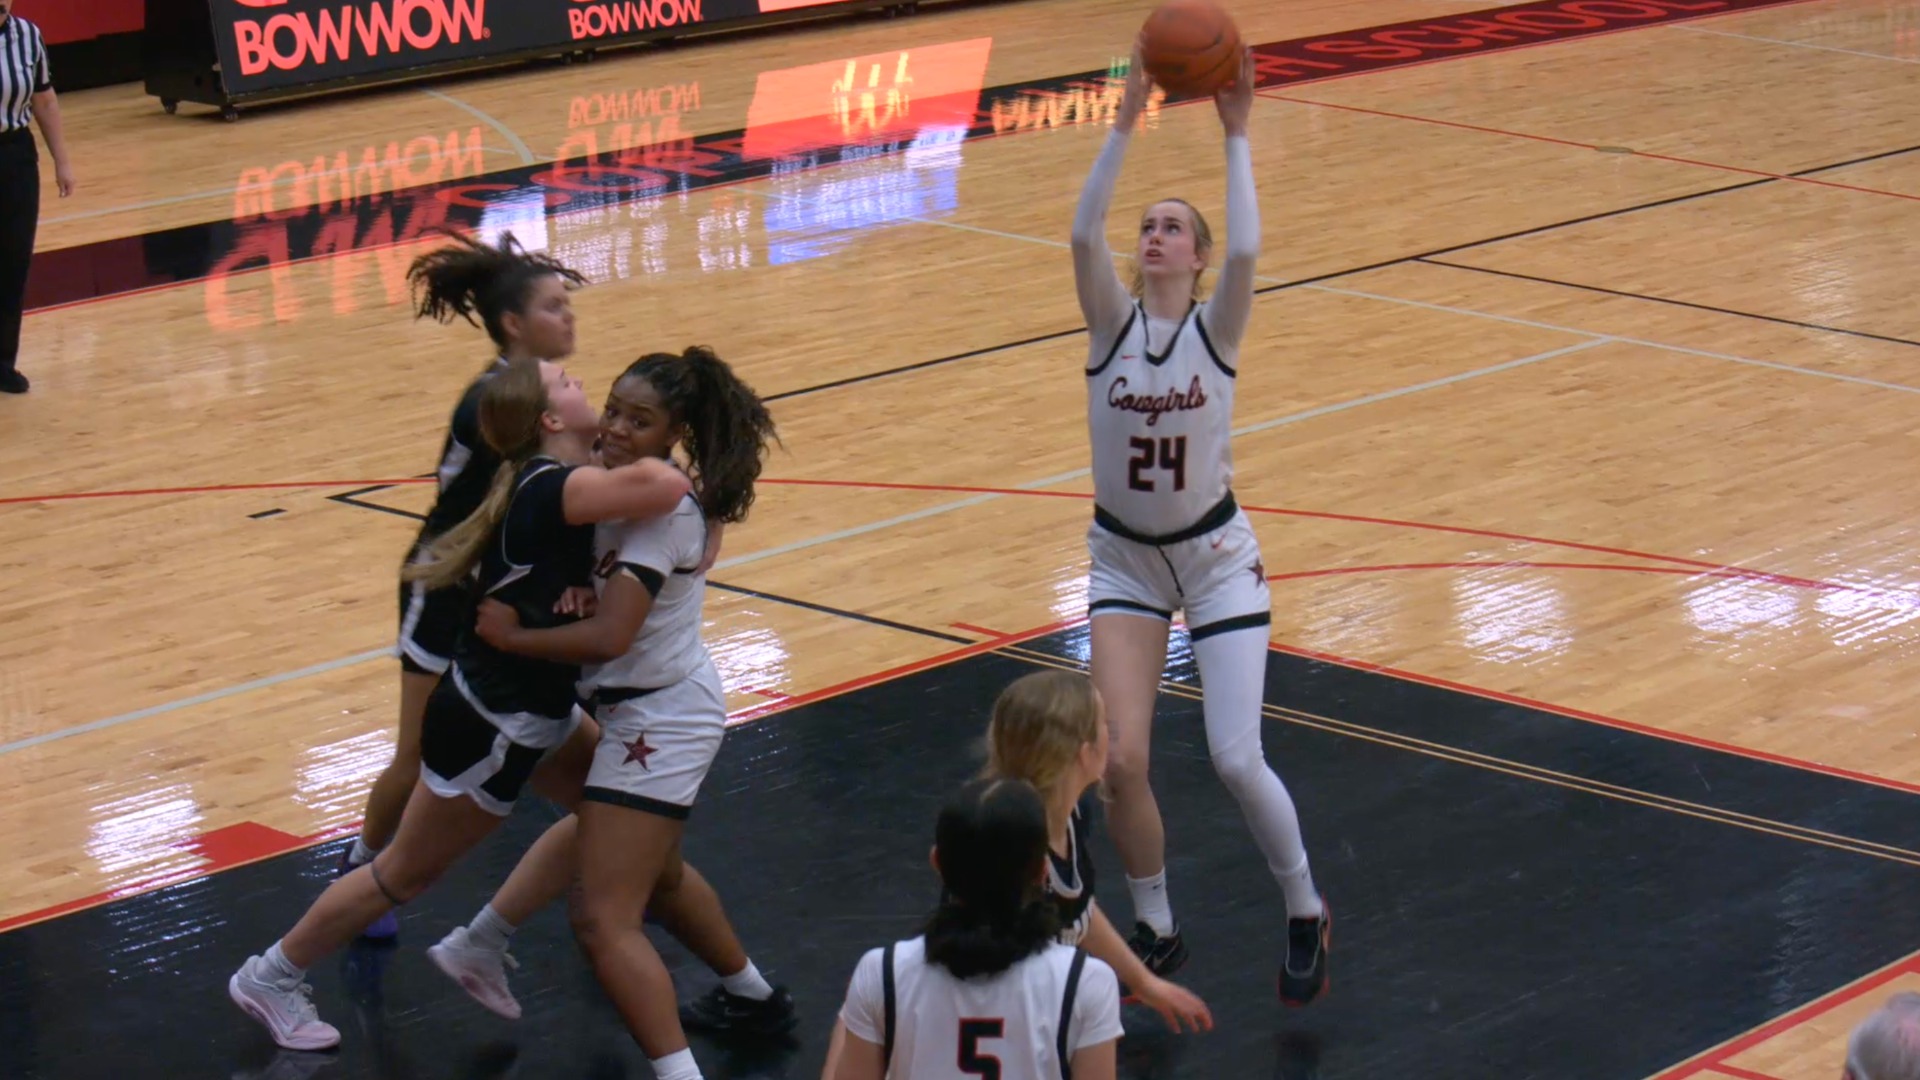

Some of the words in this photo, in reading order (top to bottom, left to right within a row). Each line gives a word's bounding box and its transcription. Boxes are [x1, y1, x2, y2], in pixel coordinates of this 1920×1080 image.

[1302, 0, 1728, 59] SCHOOL
[1107, 374, 1208, 426] Cowgirls
[1128, 436, 1188, 492] 24
[957, 1017, 1005, 1080] 5
